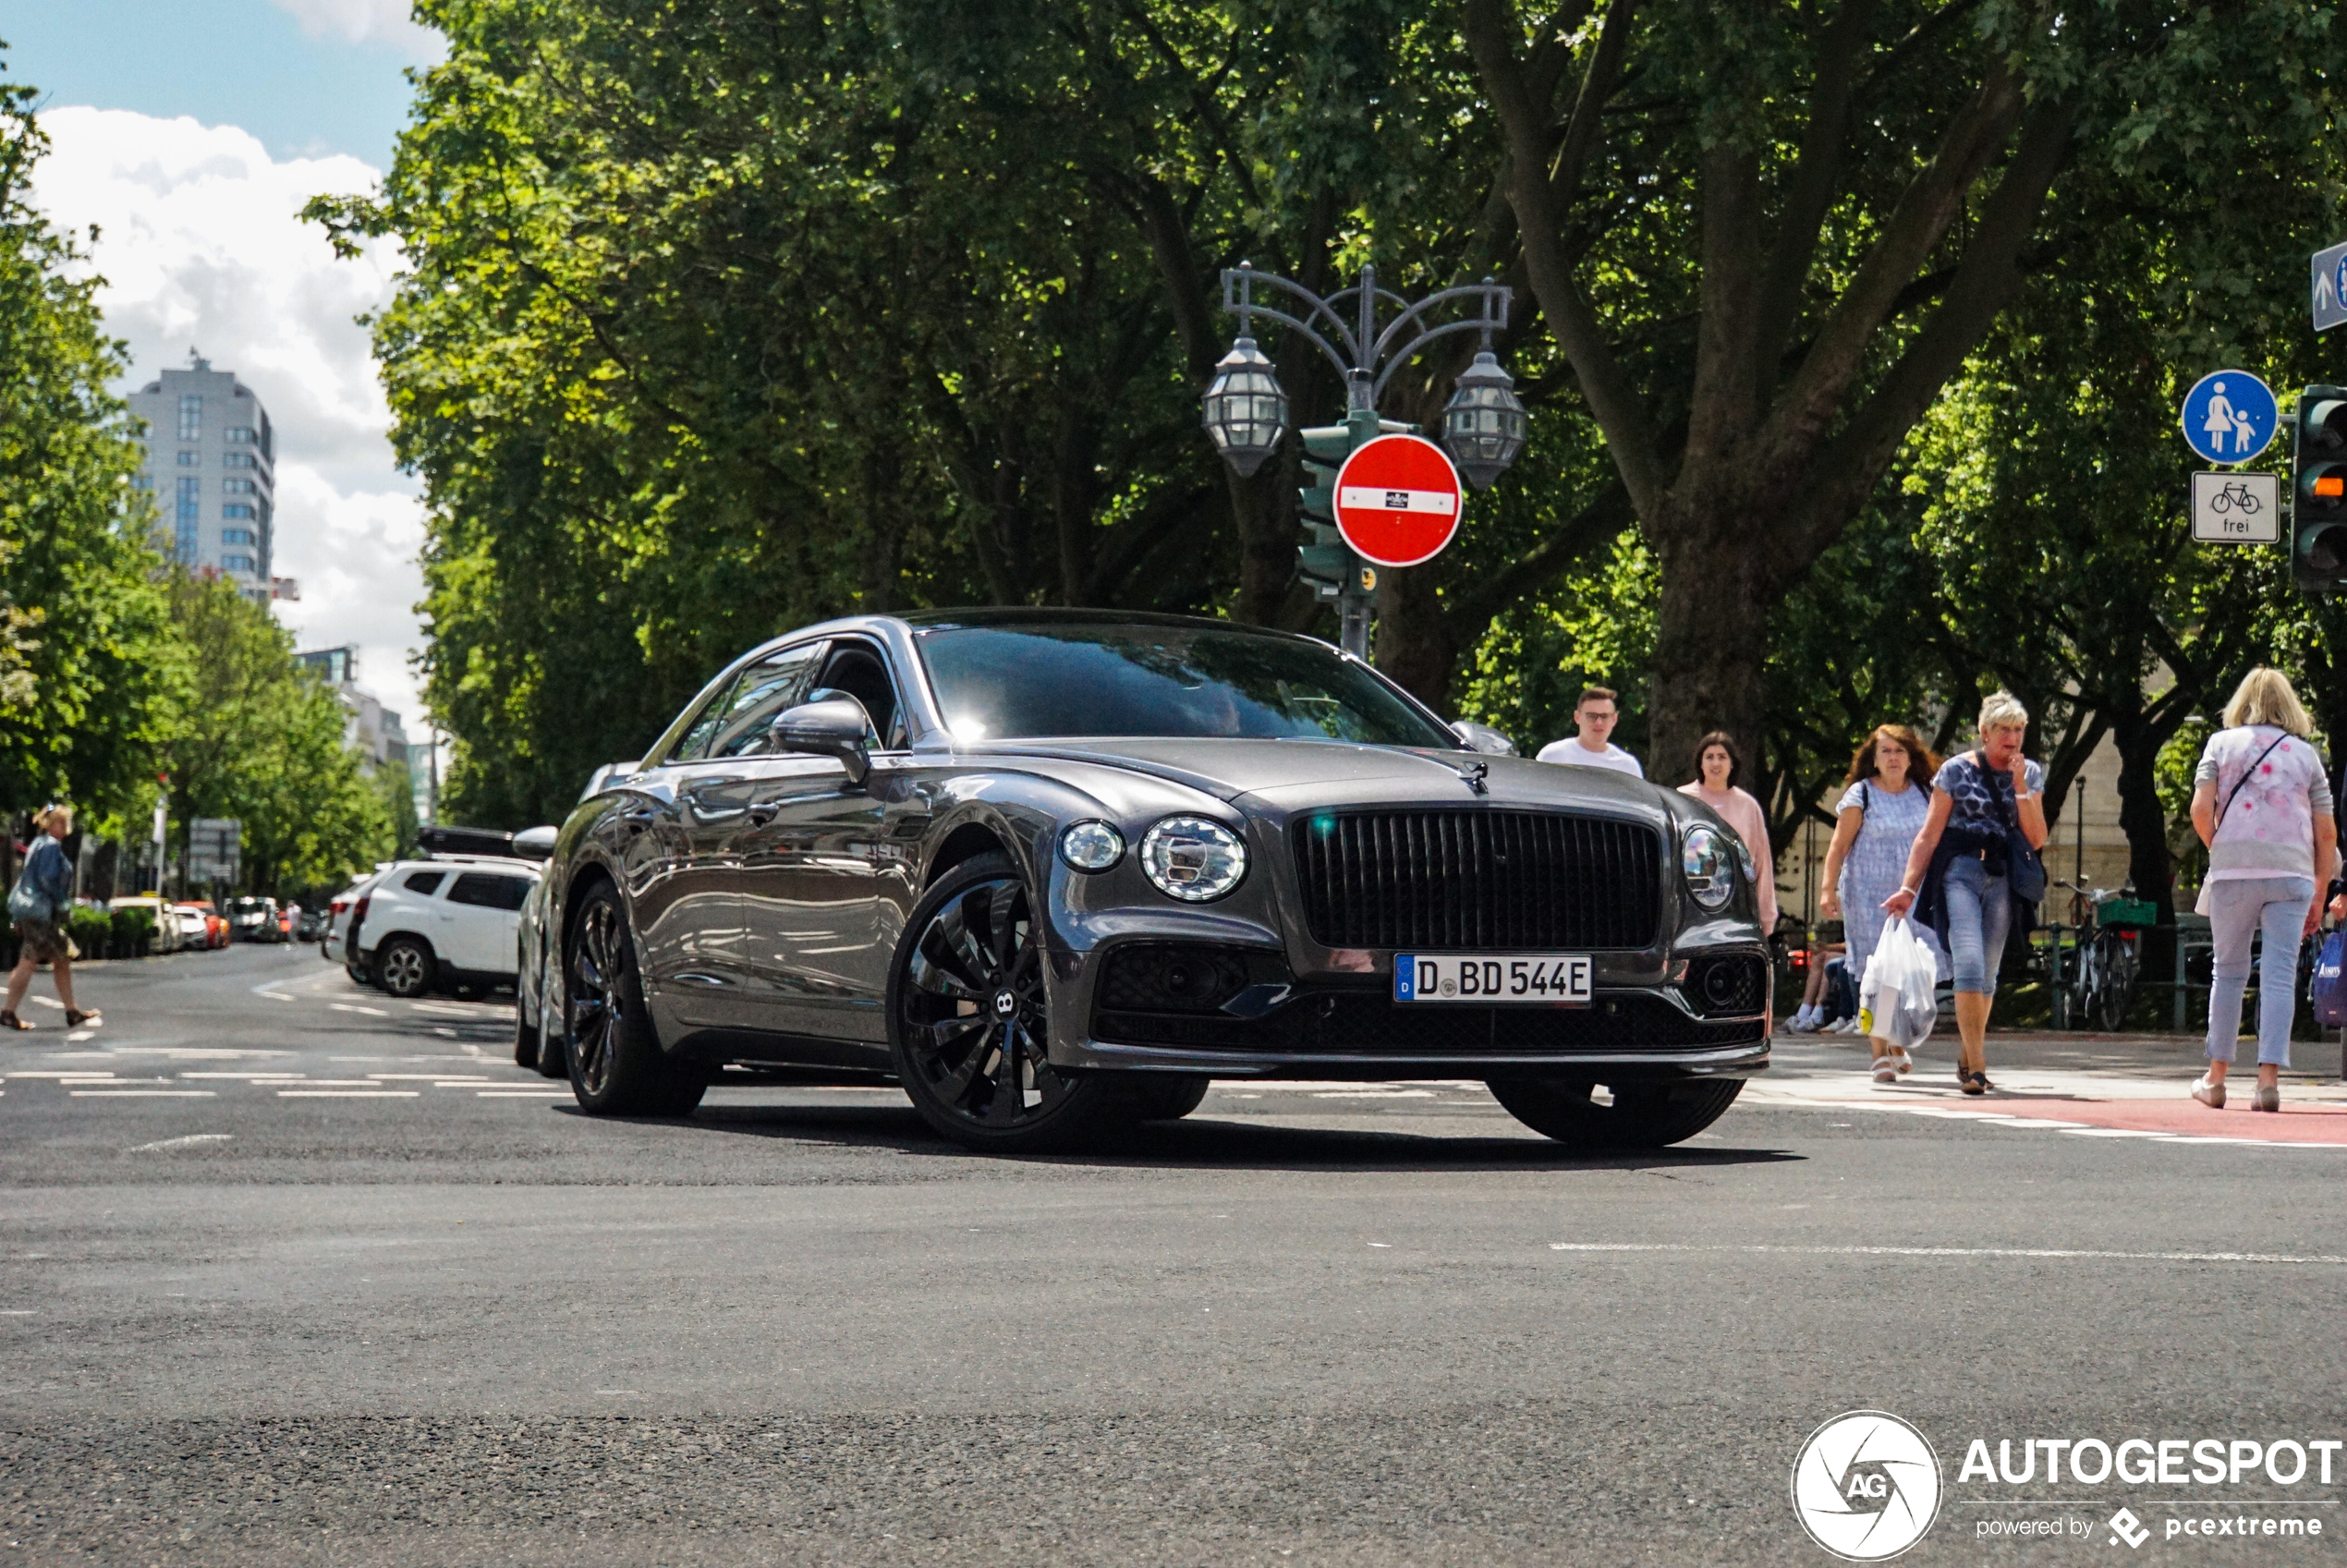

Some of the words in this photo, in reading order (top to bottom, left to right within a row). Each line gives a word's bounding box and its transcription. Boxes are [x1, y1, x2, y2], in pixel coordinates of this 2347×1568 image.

[2223, 518, 2249, 533] frei
[1417, 961, 1438, 994] D
[1460, 961, 1502, 995] BD
[1510, 962, 1587, 995] 544E
[1401, 981, 1409, 993] D
